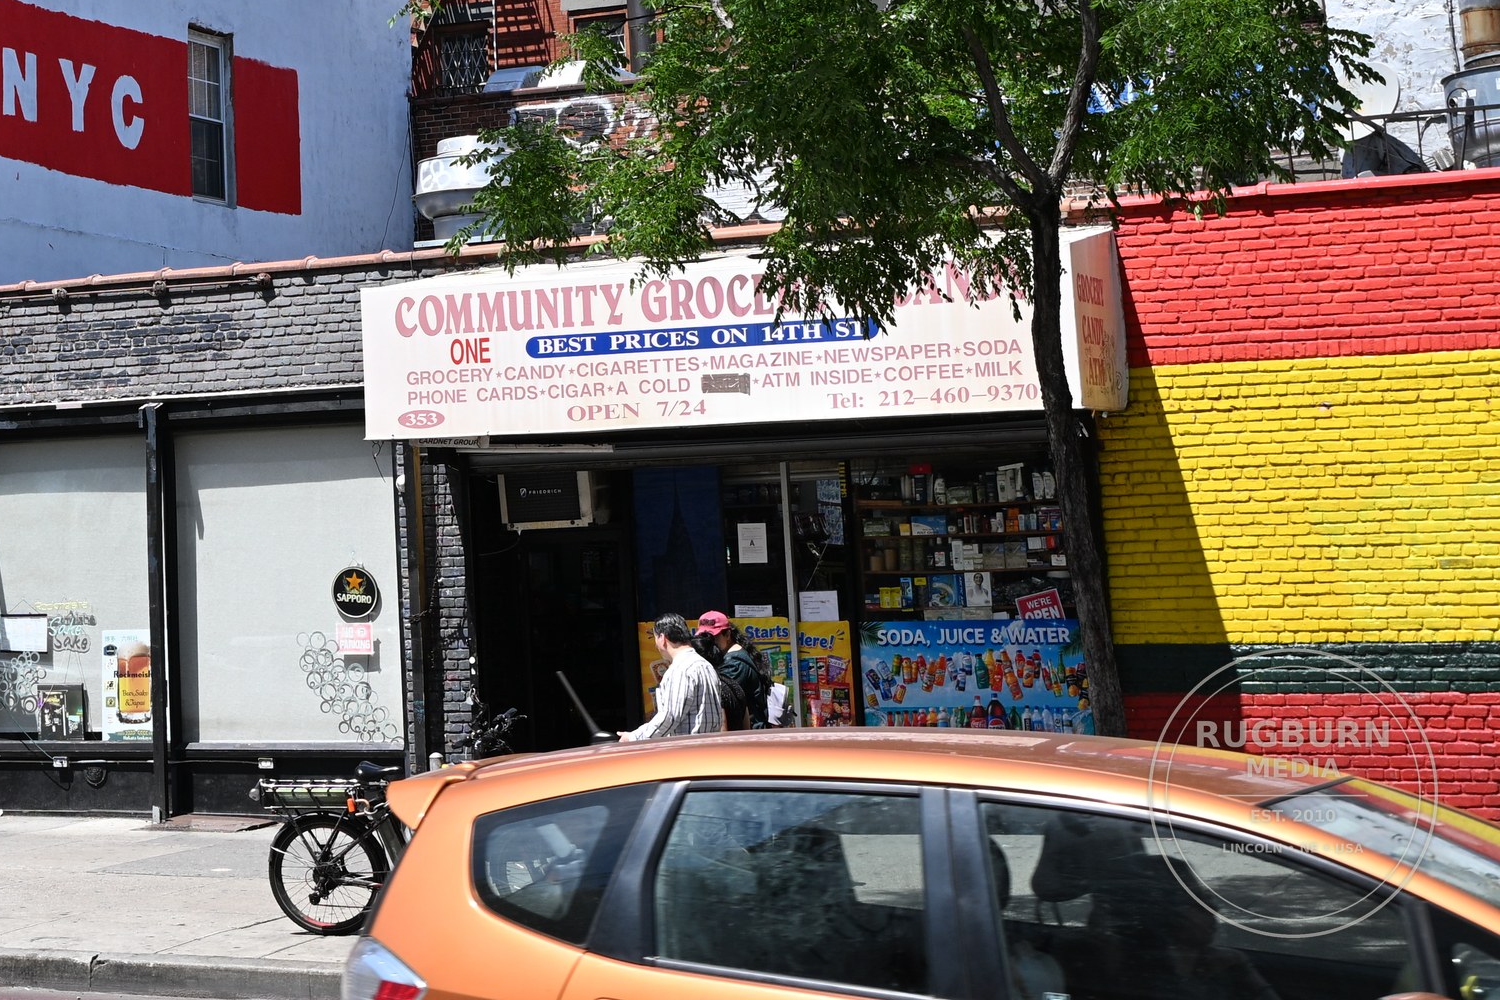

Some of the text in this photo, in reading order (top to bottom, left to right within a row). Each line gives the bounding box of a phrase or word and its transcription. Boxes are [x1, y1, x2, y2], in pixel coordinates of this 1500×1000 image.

[1076, 272, 1104, 307] GROCERY
[395, 283, 625, 338] COMMUNITY
[537, 335, 597, 355] BEST
[609, 330, 699, 350] PRICES
[711, 327, 748, 345] ON
[762, 322, 822, 343] 14TH
[450, 337, 491, 365] ONE
[406, 339, 1022, 385] GROCERY CANDY CIGARETTES MAGAZINE NEWSPAPER SODA
[407, 360, 1023, 405] PHONE CARDS CIGAR A COLD ATM INSIDE COFFEE MILK
[566, 399, 707, 422] OPEN 7/24
[827, 392, 864, 410] Tel:
[405, 413, 438, 426] 353
[337, 593, 372, 604] SAPPORO
[1026, 596, 1053, 610] WE'RE
[342, 627, 354, 638] NO
[744, 625, 790, 640] Starts
[877, 626, 1071, 647] SODA, JUICE & WATER
[340, 640, 371, 650] PARKING
